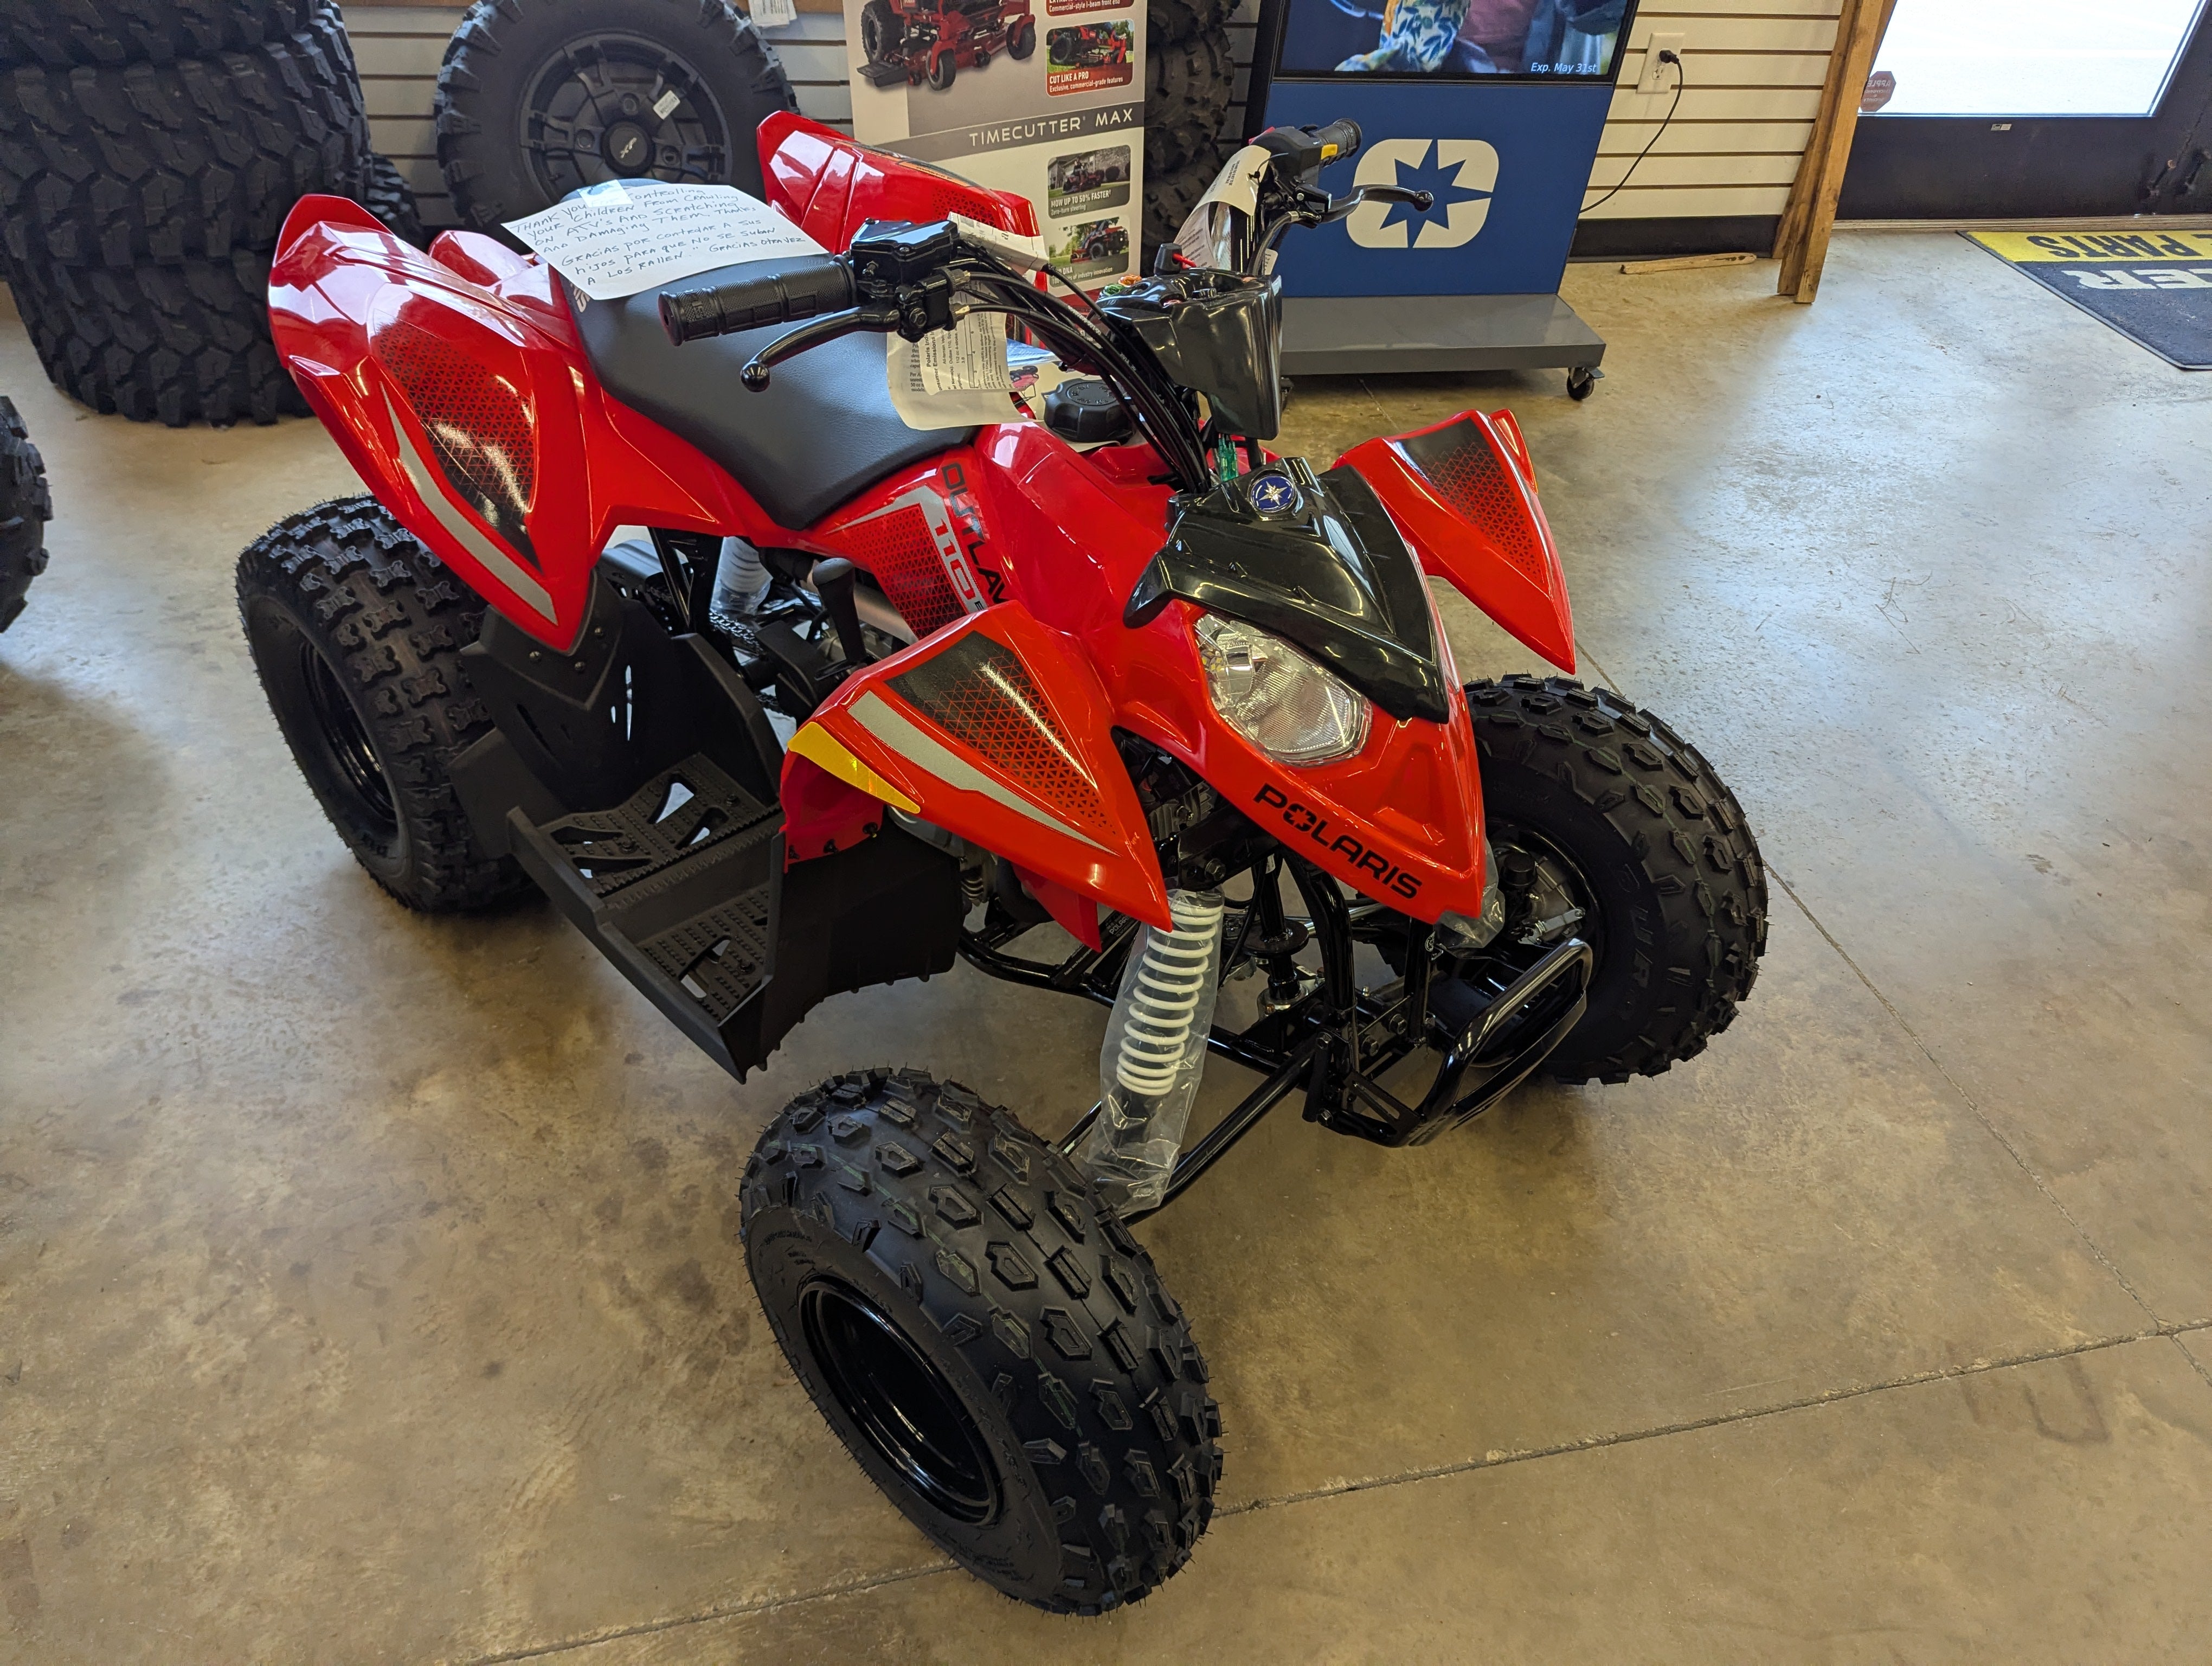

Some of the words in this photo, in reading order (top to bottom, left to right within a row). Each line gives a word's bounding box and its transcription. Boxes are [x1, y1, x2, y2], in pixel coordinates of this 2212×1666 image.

[1531, 62, 1551, 74] Exp.
[1554, 63, 1574, 74] May
[1576, 63, 1597, 72] 31st
[1049, 74, 1060, 84] CUT
[1061, 73, 1072, 82] LIKE
[1073, 72, 1078, 81] A
[1078, 71, 1089, 80] PRO
[1070, 78, 1107, 89] commercial-grade
[1096, 108, 1133, 127] MAX
[1051, 198, 1063, 208] MOW
[1063, 197, 1071, 206] UP
[1071, 196, 1078, 204] TO
[1079, 194, 1090, 202] 50%
[1051, 207, 1069, 216] Zero-turn
[1070, 204, 1086, 214] steering
[2027, 234, 2204, 258] PARTS
[1063, 267, 1073, 275] DNA
[587, 277, 596, 286] A
[2061, 268, 2212, 289] ER
[1253, 784, 1423, 899] POLARIS
